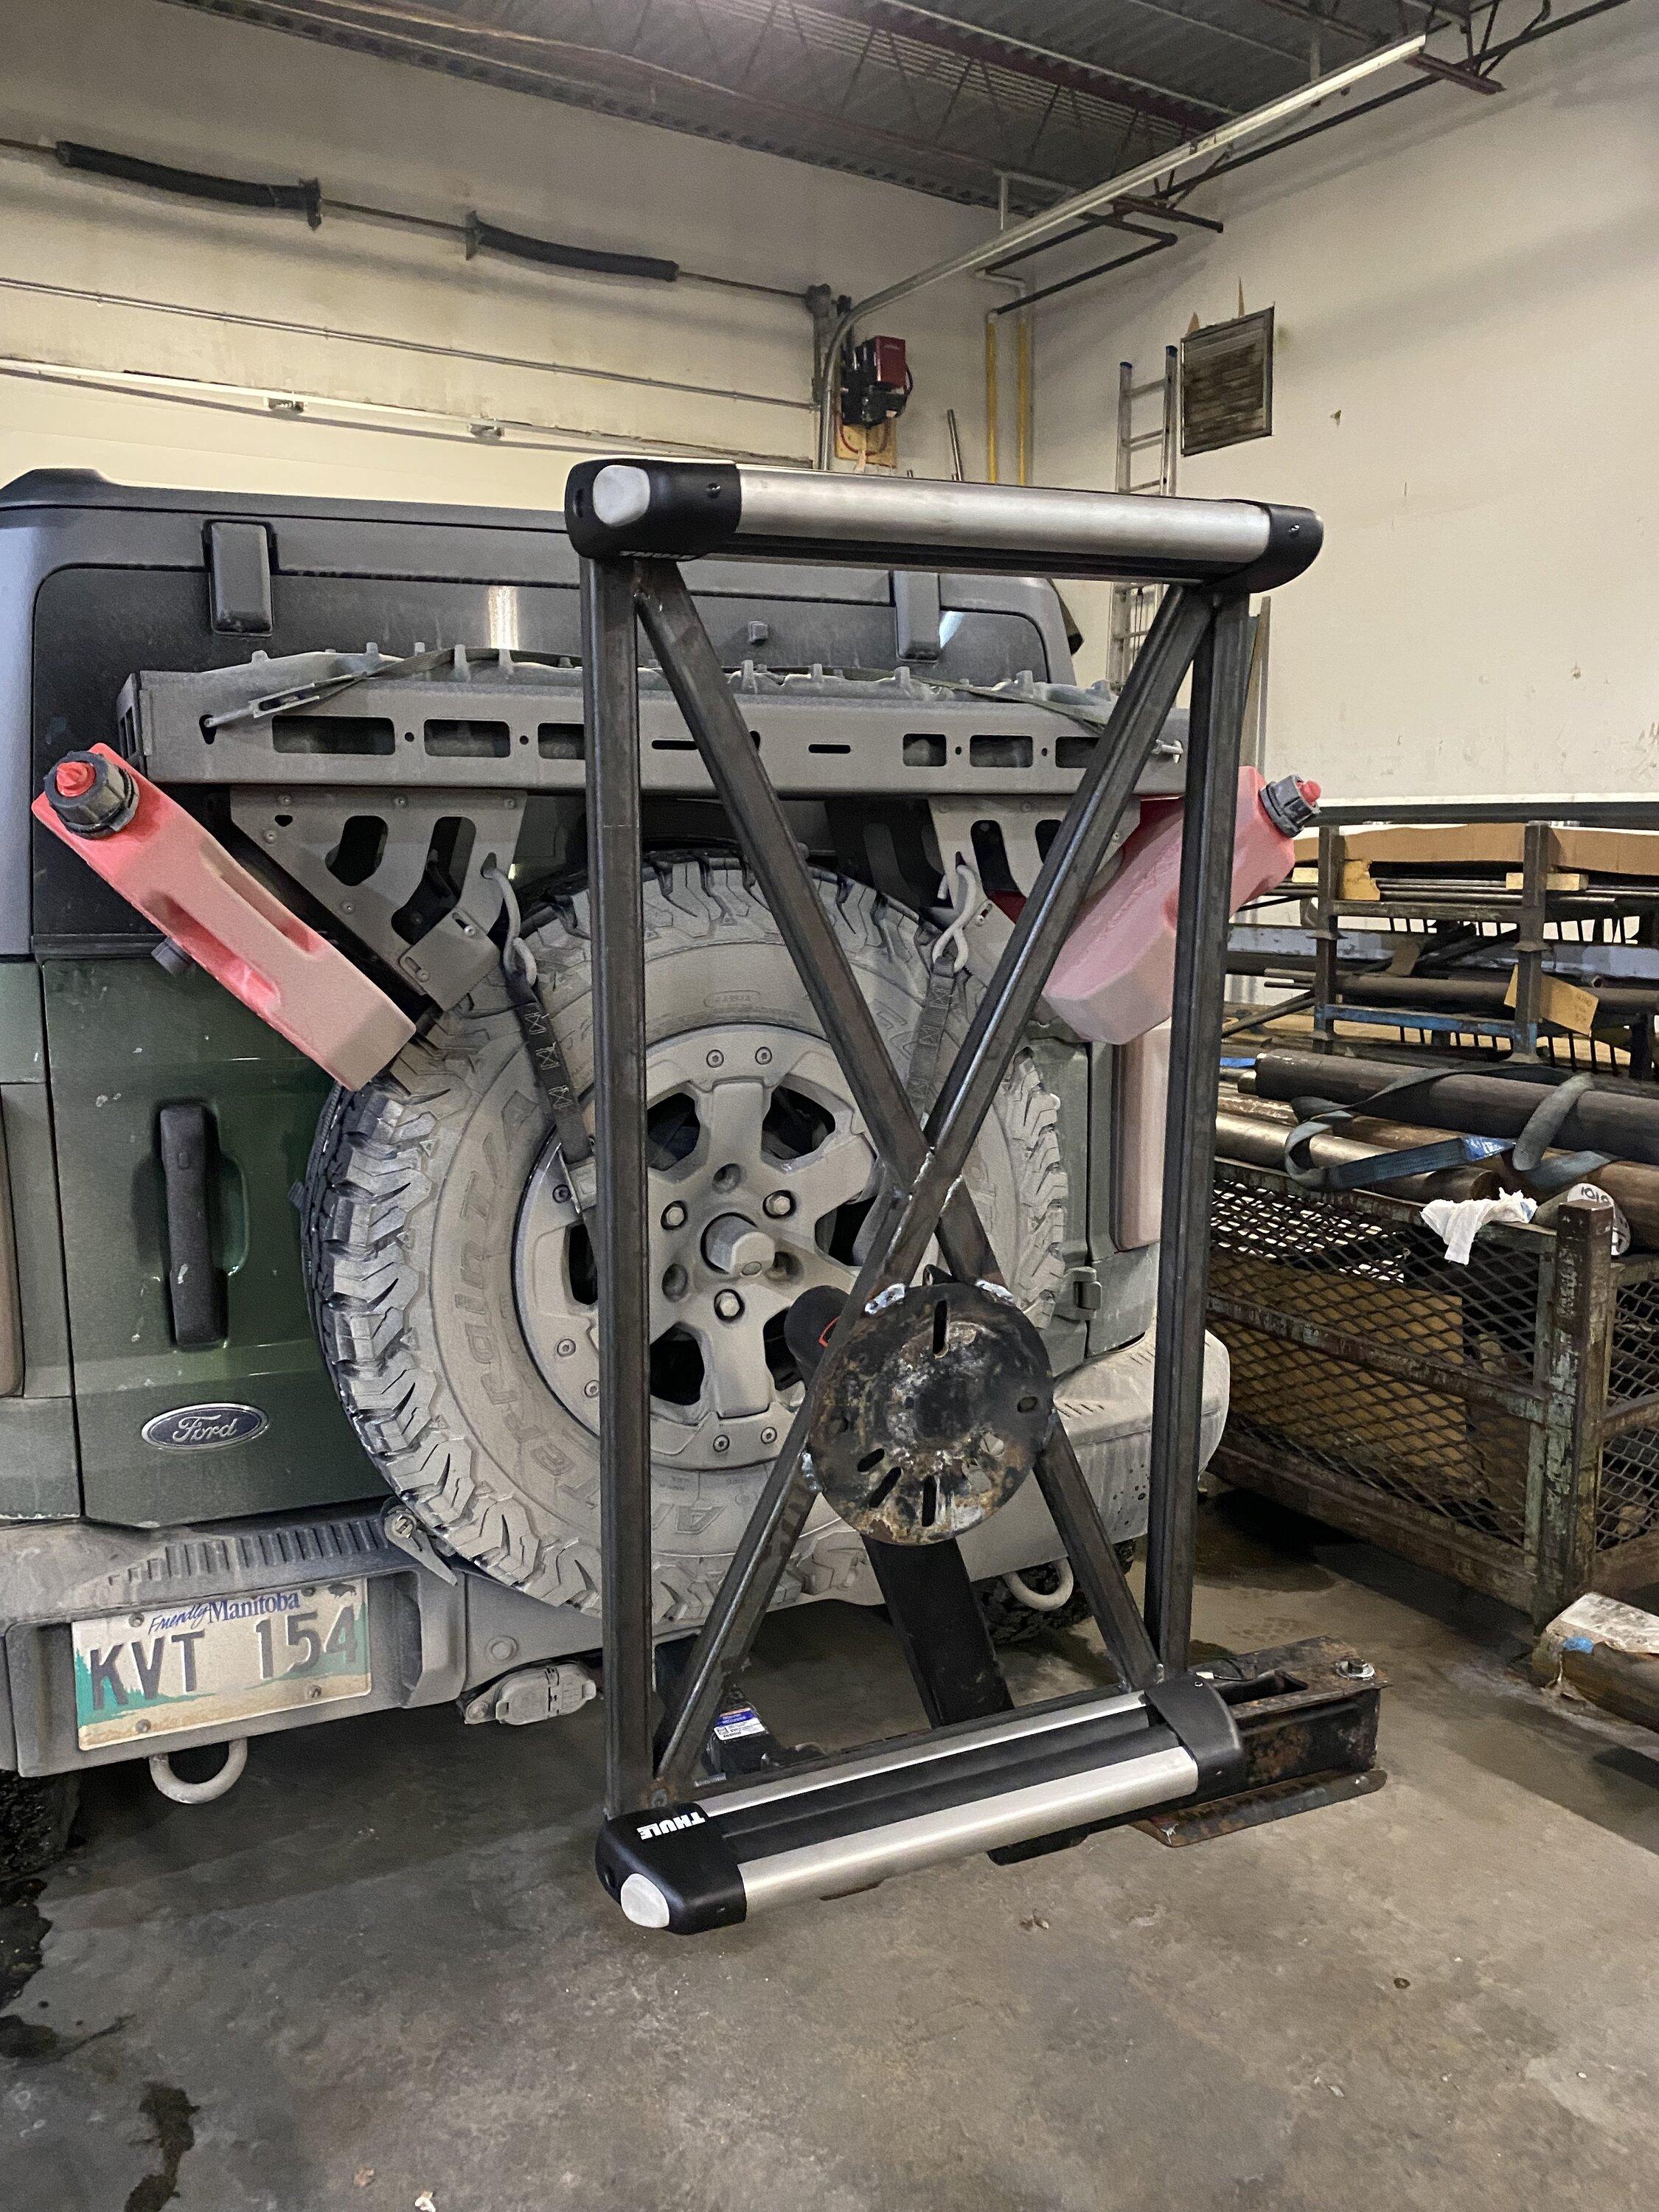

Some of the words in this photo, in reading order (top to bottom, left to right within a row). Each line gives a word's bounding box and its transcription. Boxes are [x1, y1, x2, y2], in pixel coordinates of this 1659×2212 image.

[172, 1414, 238, 1442] Ford
[147, 1602, 212, 1635] Friendly
[209, 1592, 301, 1624] Manitoba
[89, 1630, 206, 1711] KVT
[255, 1604, 358, 1680] 154
[637, 1812, 706, 1840] THULE
